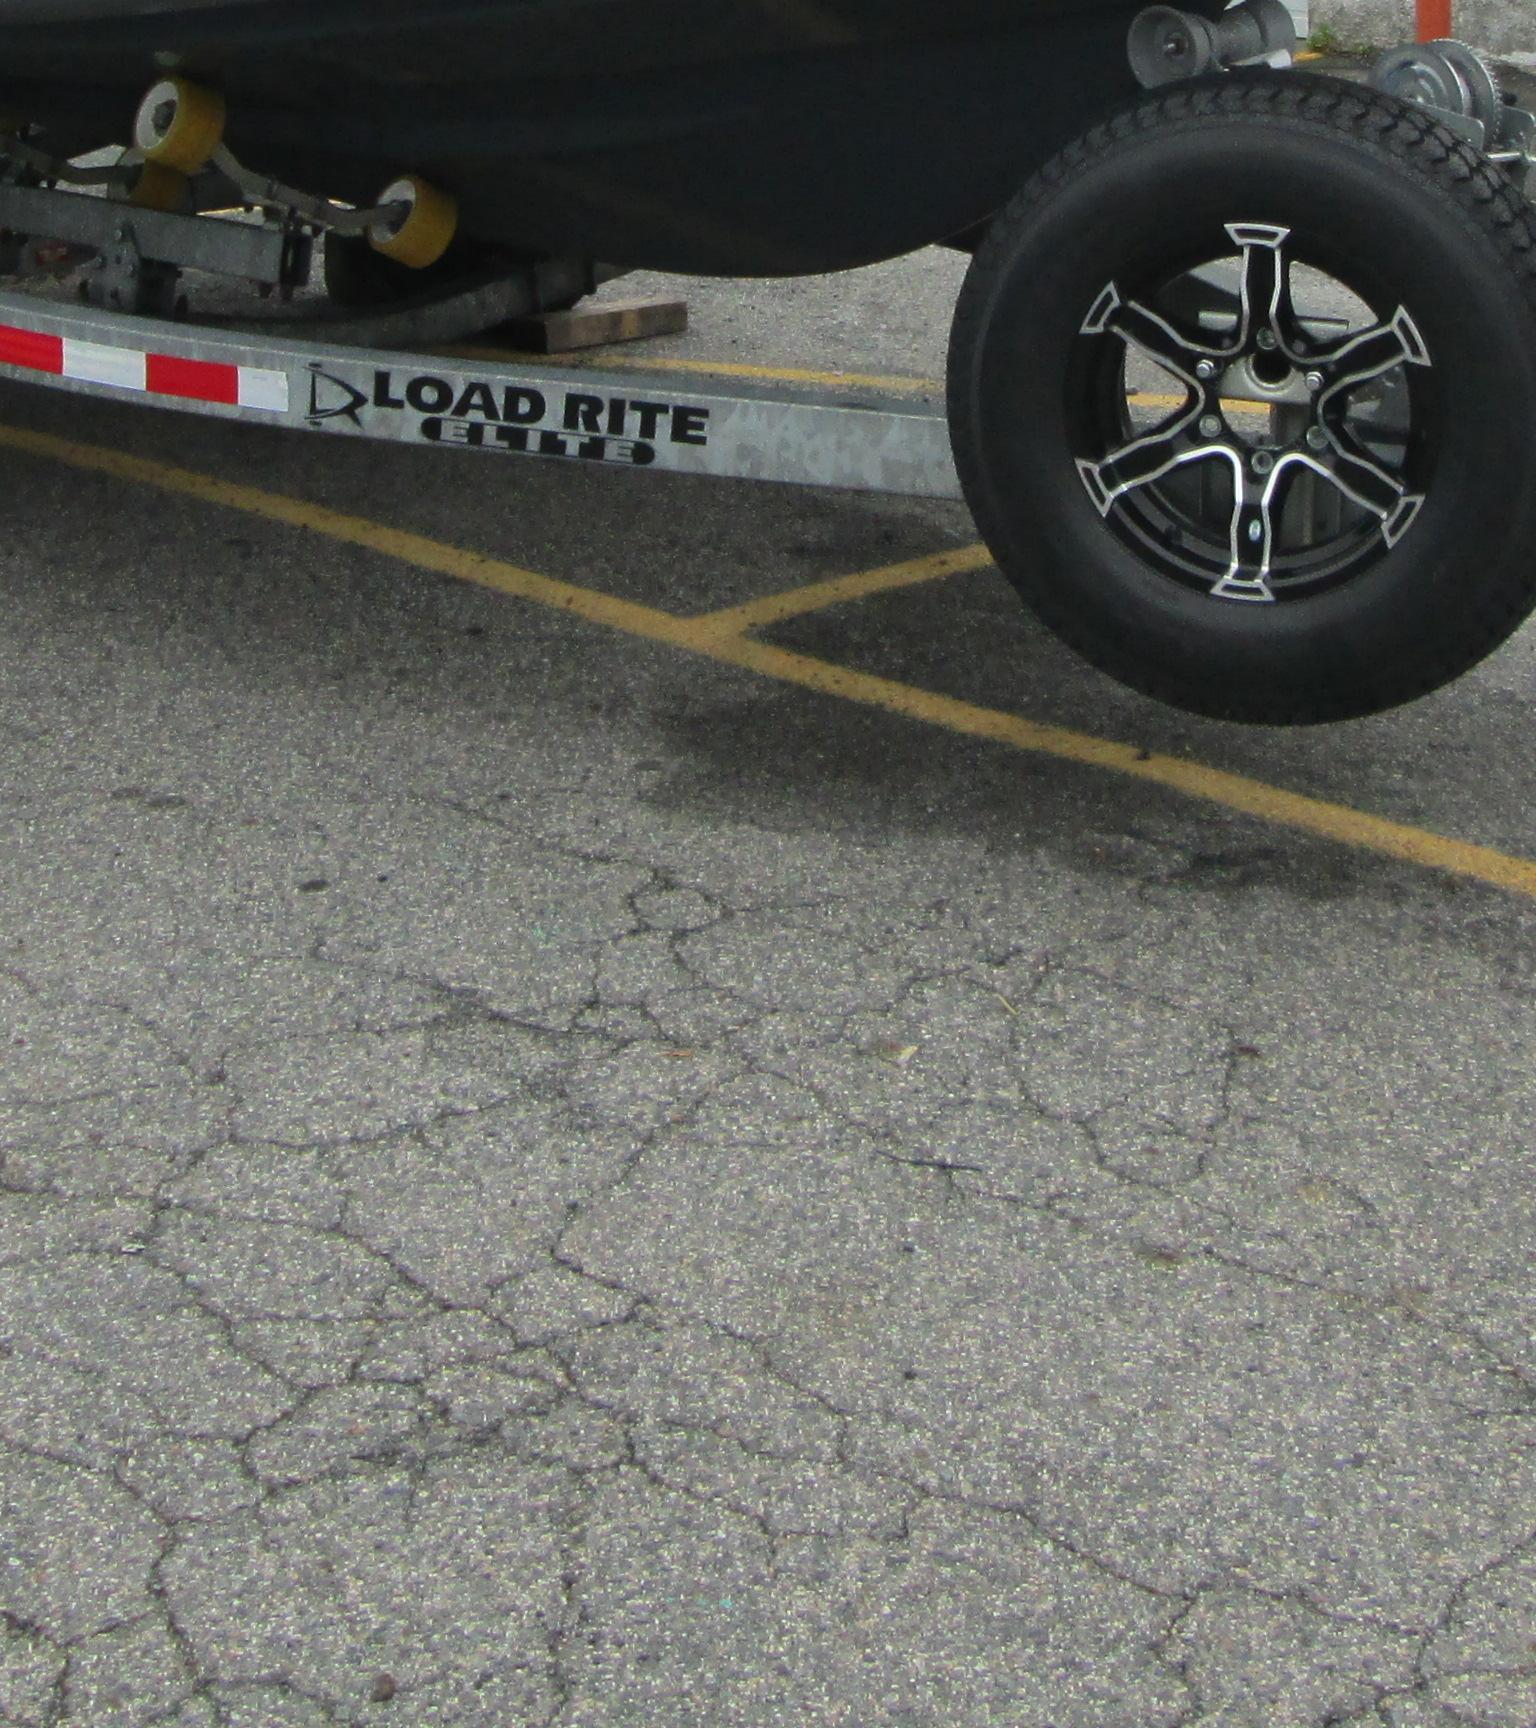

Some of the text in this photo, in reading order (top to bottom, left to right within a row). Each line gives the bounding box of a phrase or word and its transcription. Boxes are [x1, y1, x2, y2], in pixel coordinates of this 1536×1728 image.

[373, 370, 711, 446] LOAD RITE
[439, 418, 635, 465] ELITE
